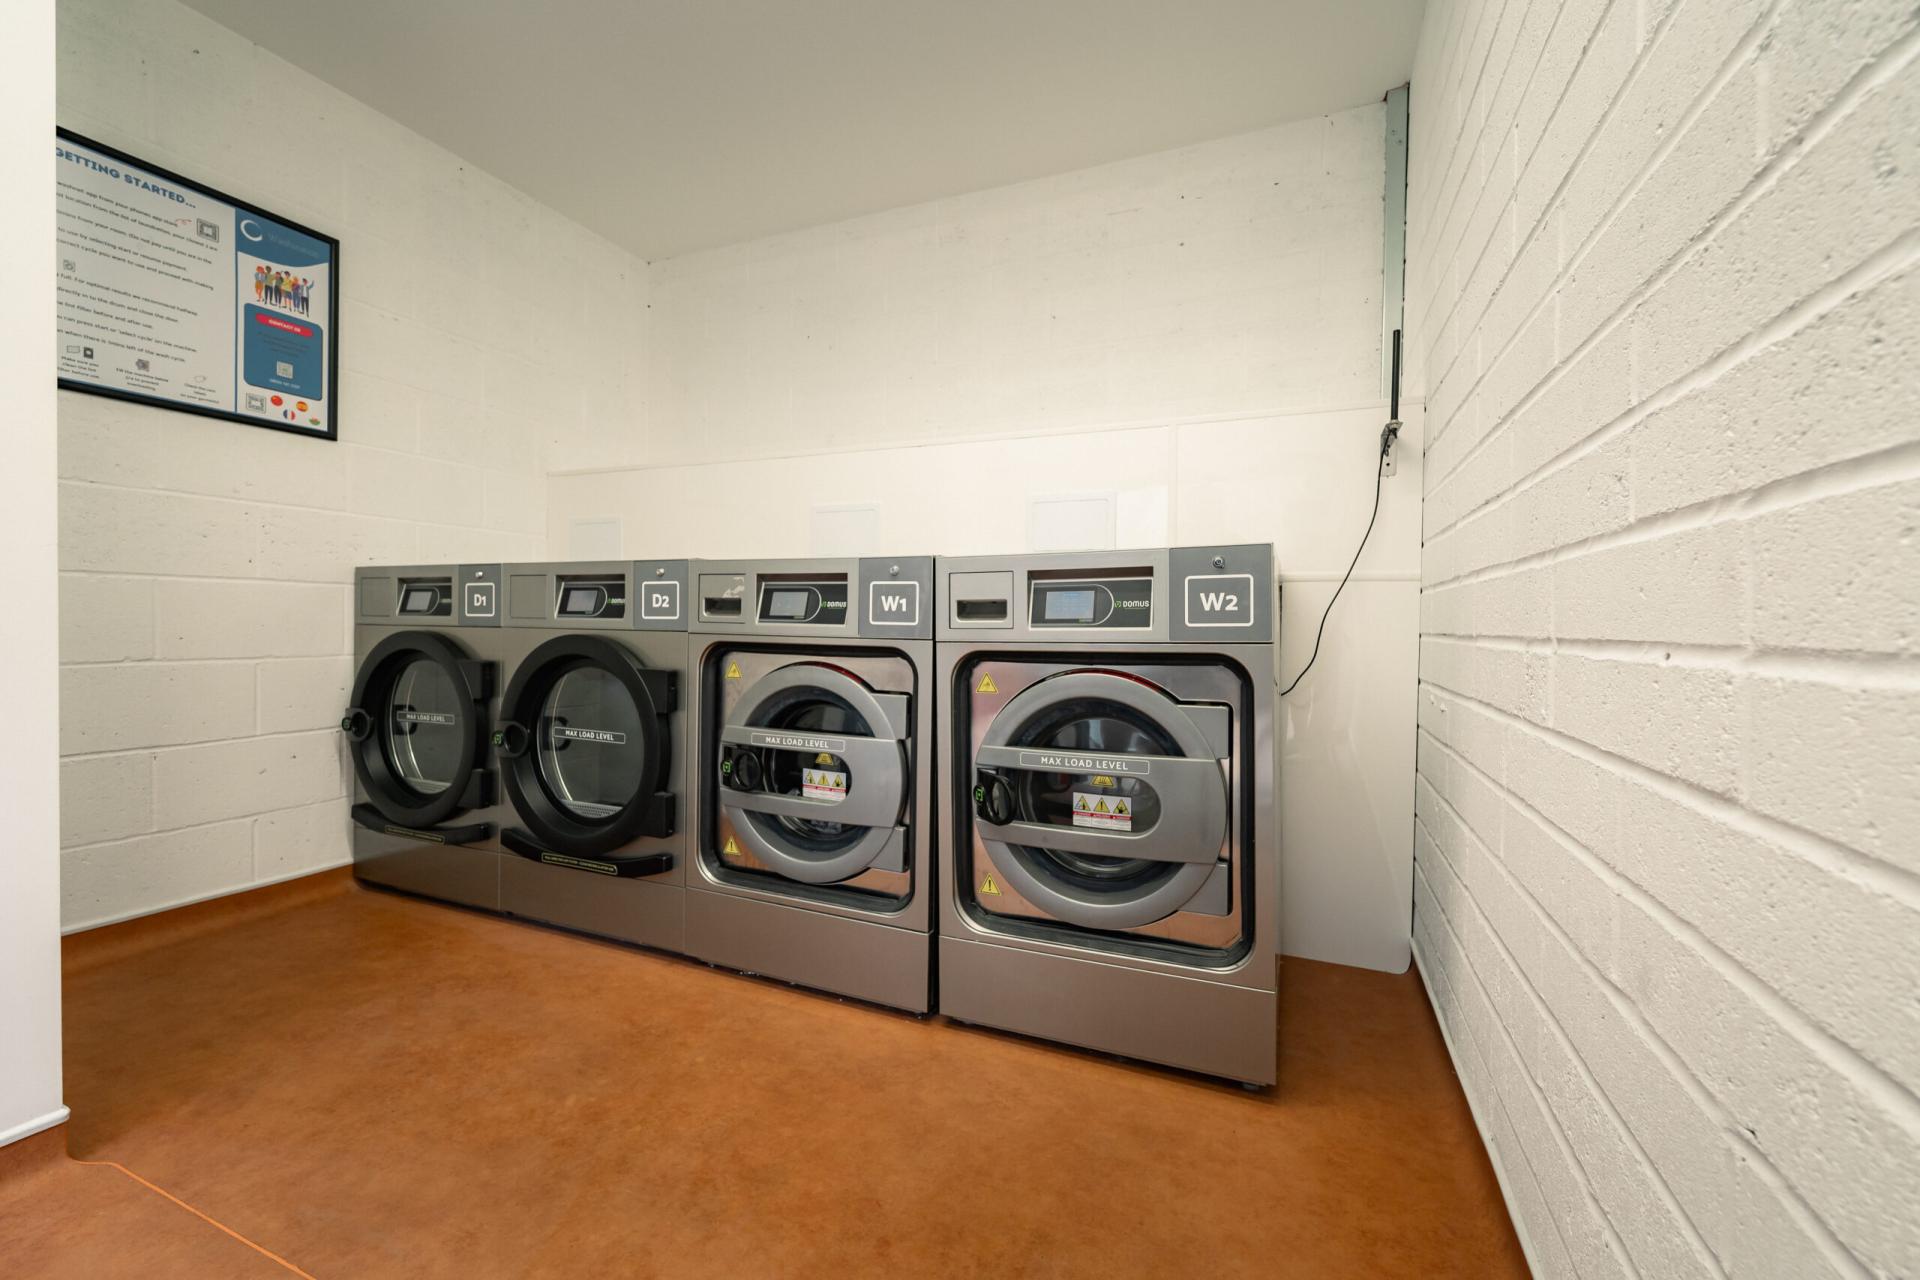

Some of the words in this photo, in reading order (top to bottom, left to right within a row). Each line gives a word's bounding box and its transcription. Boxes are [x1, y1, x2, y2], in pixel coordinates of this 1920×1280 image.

[124, 174, 196, 208] STARTED...
[474, 594, 487, 606] D1
[652, 593, 670, 608] D2
[881, 595, 907, 612] W1
[1200, 592, 1238, 611] W2
[596, 733, 614, 741] LEVEL
[765, 736, 780, 744] MAX
[783, 738, 803, 746] LOAD
[805, 740, 829, 748] LEVEL
[1040, 756, 1062, 765] MAX
[1064, 758, 1092, 768] LOAD
[1096, 760, 1128, 770] LEVEL
